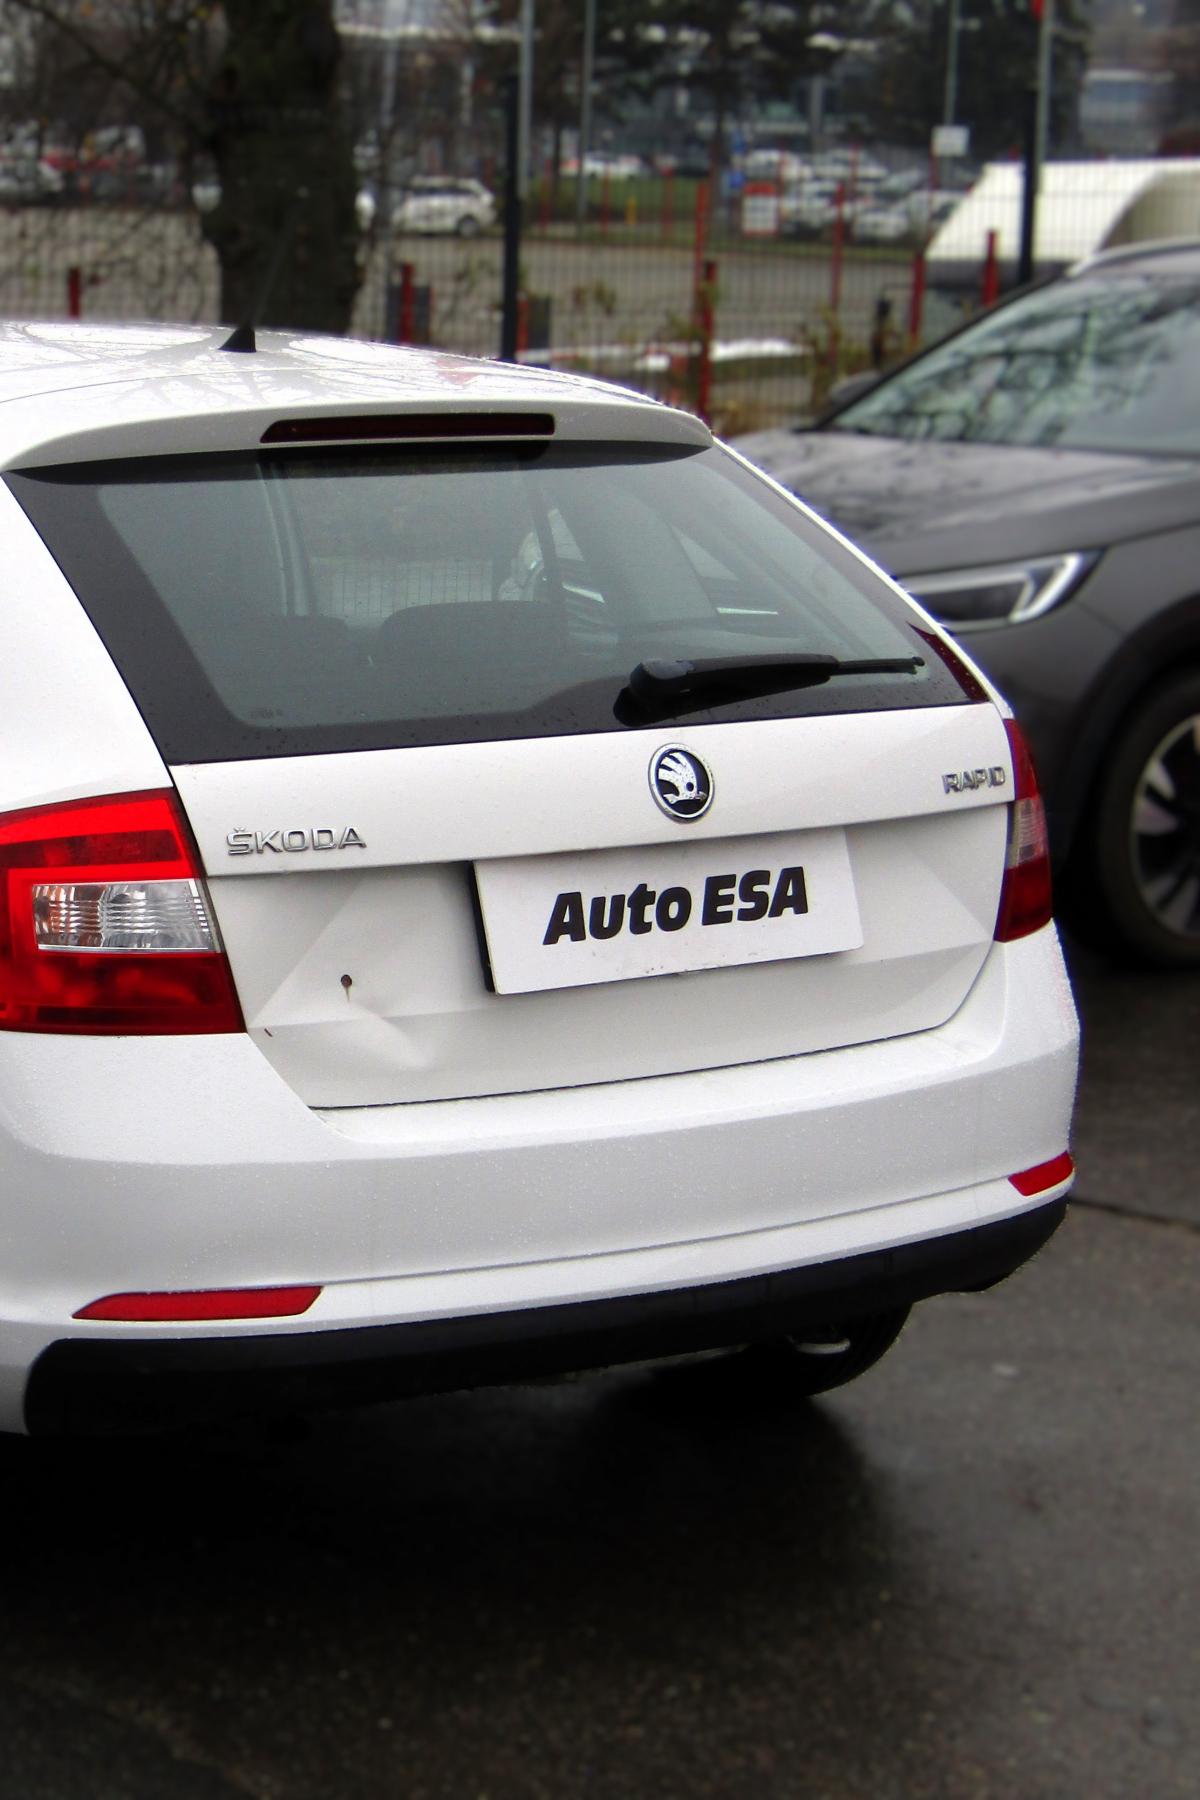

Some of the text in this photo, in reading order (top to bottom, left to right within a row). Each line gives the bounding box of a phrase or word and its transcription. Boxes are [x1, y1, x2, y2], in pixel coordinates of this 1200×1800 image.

[942, 766, 1005, 794] RAPID
[226, 826, 367, 856] ŠKODA
[543, 867, 808, 945] Auto ESA
